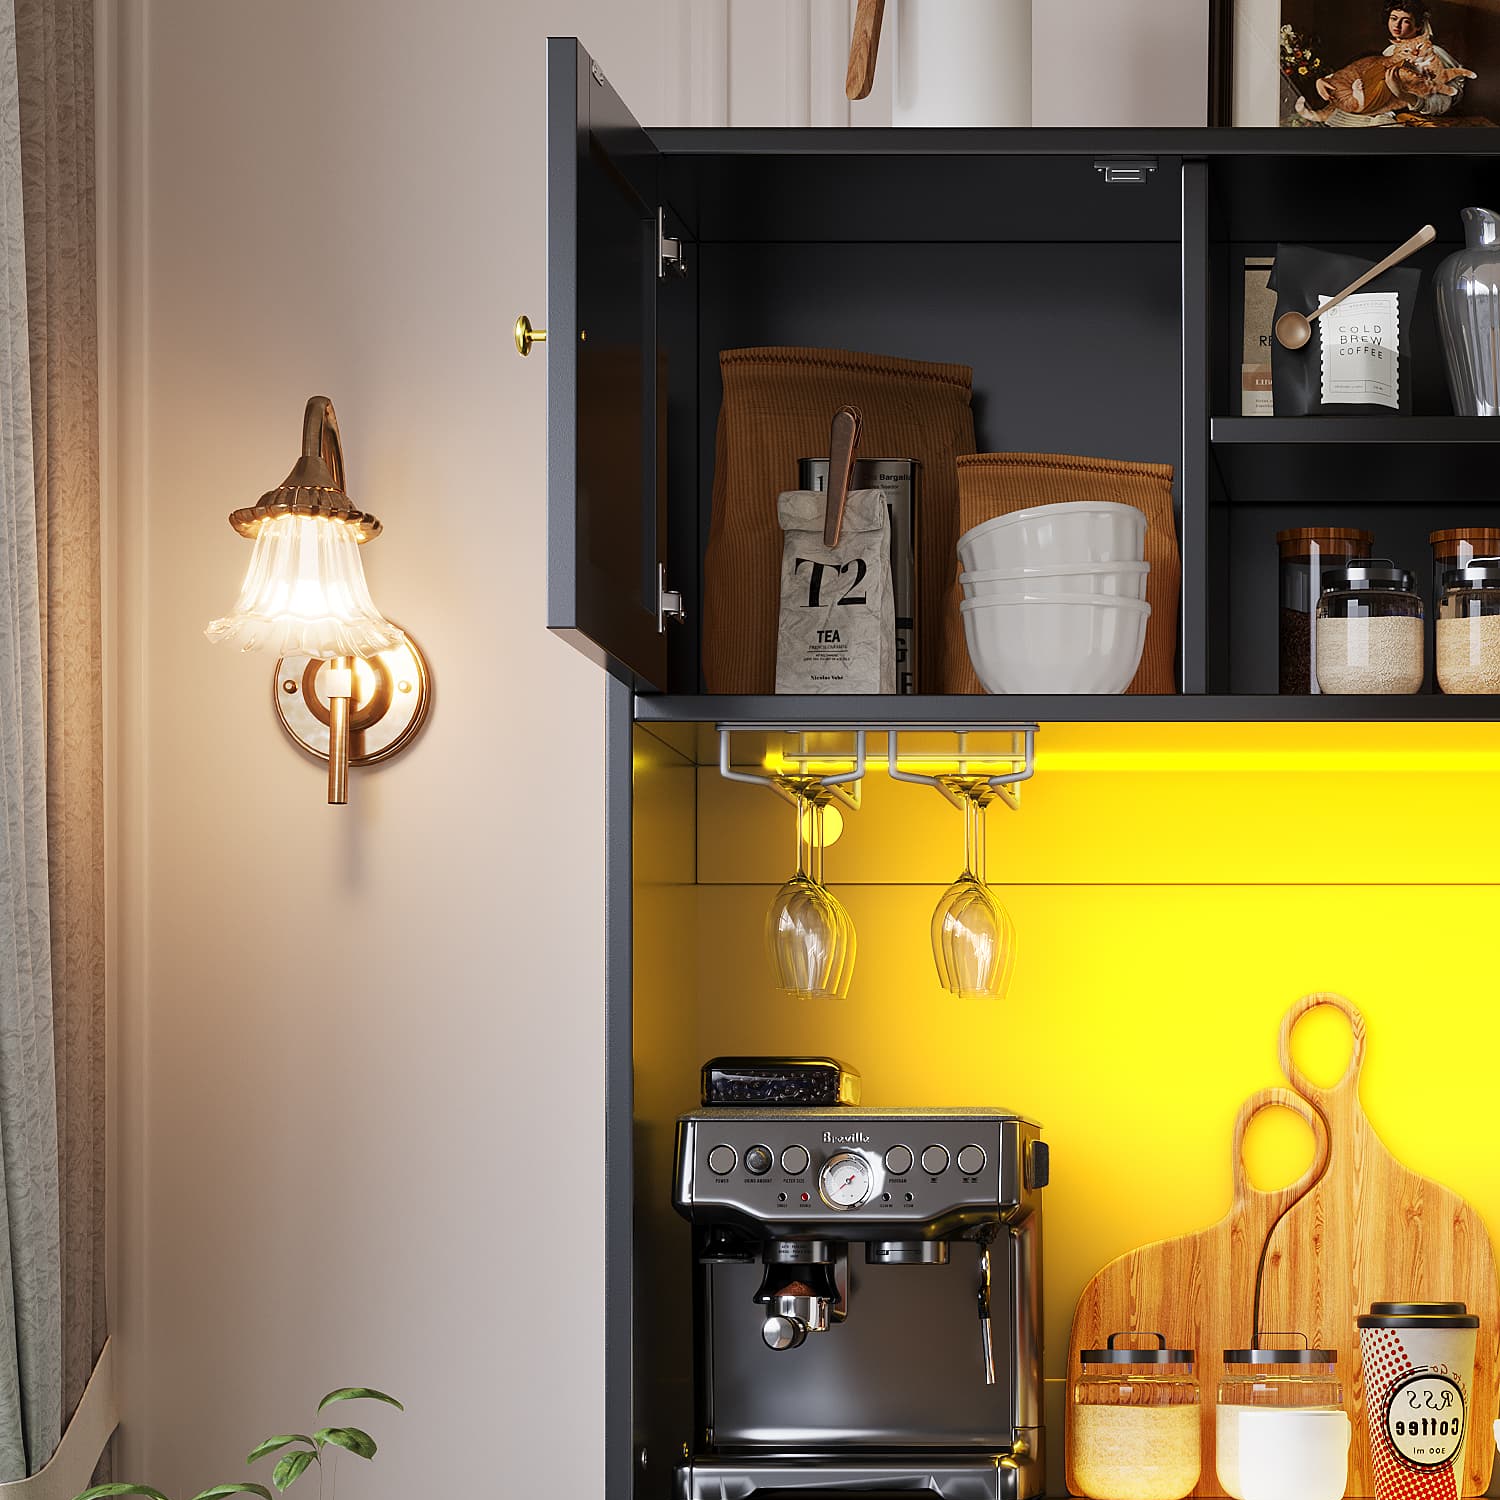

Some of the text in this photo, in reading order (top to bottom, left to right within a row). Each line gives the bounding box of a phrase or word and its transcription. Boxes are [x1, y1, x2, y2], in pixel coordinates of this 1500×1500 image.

[1338, 325, 1382, 334] COLD
[1340, 335, 1383, 346] BREW
[1339, 346, 1383, 360] COFFEE
[794, 556, 868, 608] T2
[816, 629, 841, 643] TEA
[822, 1131, 871, 1143] Breville
